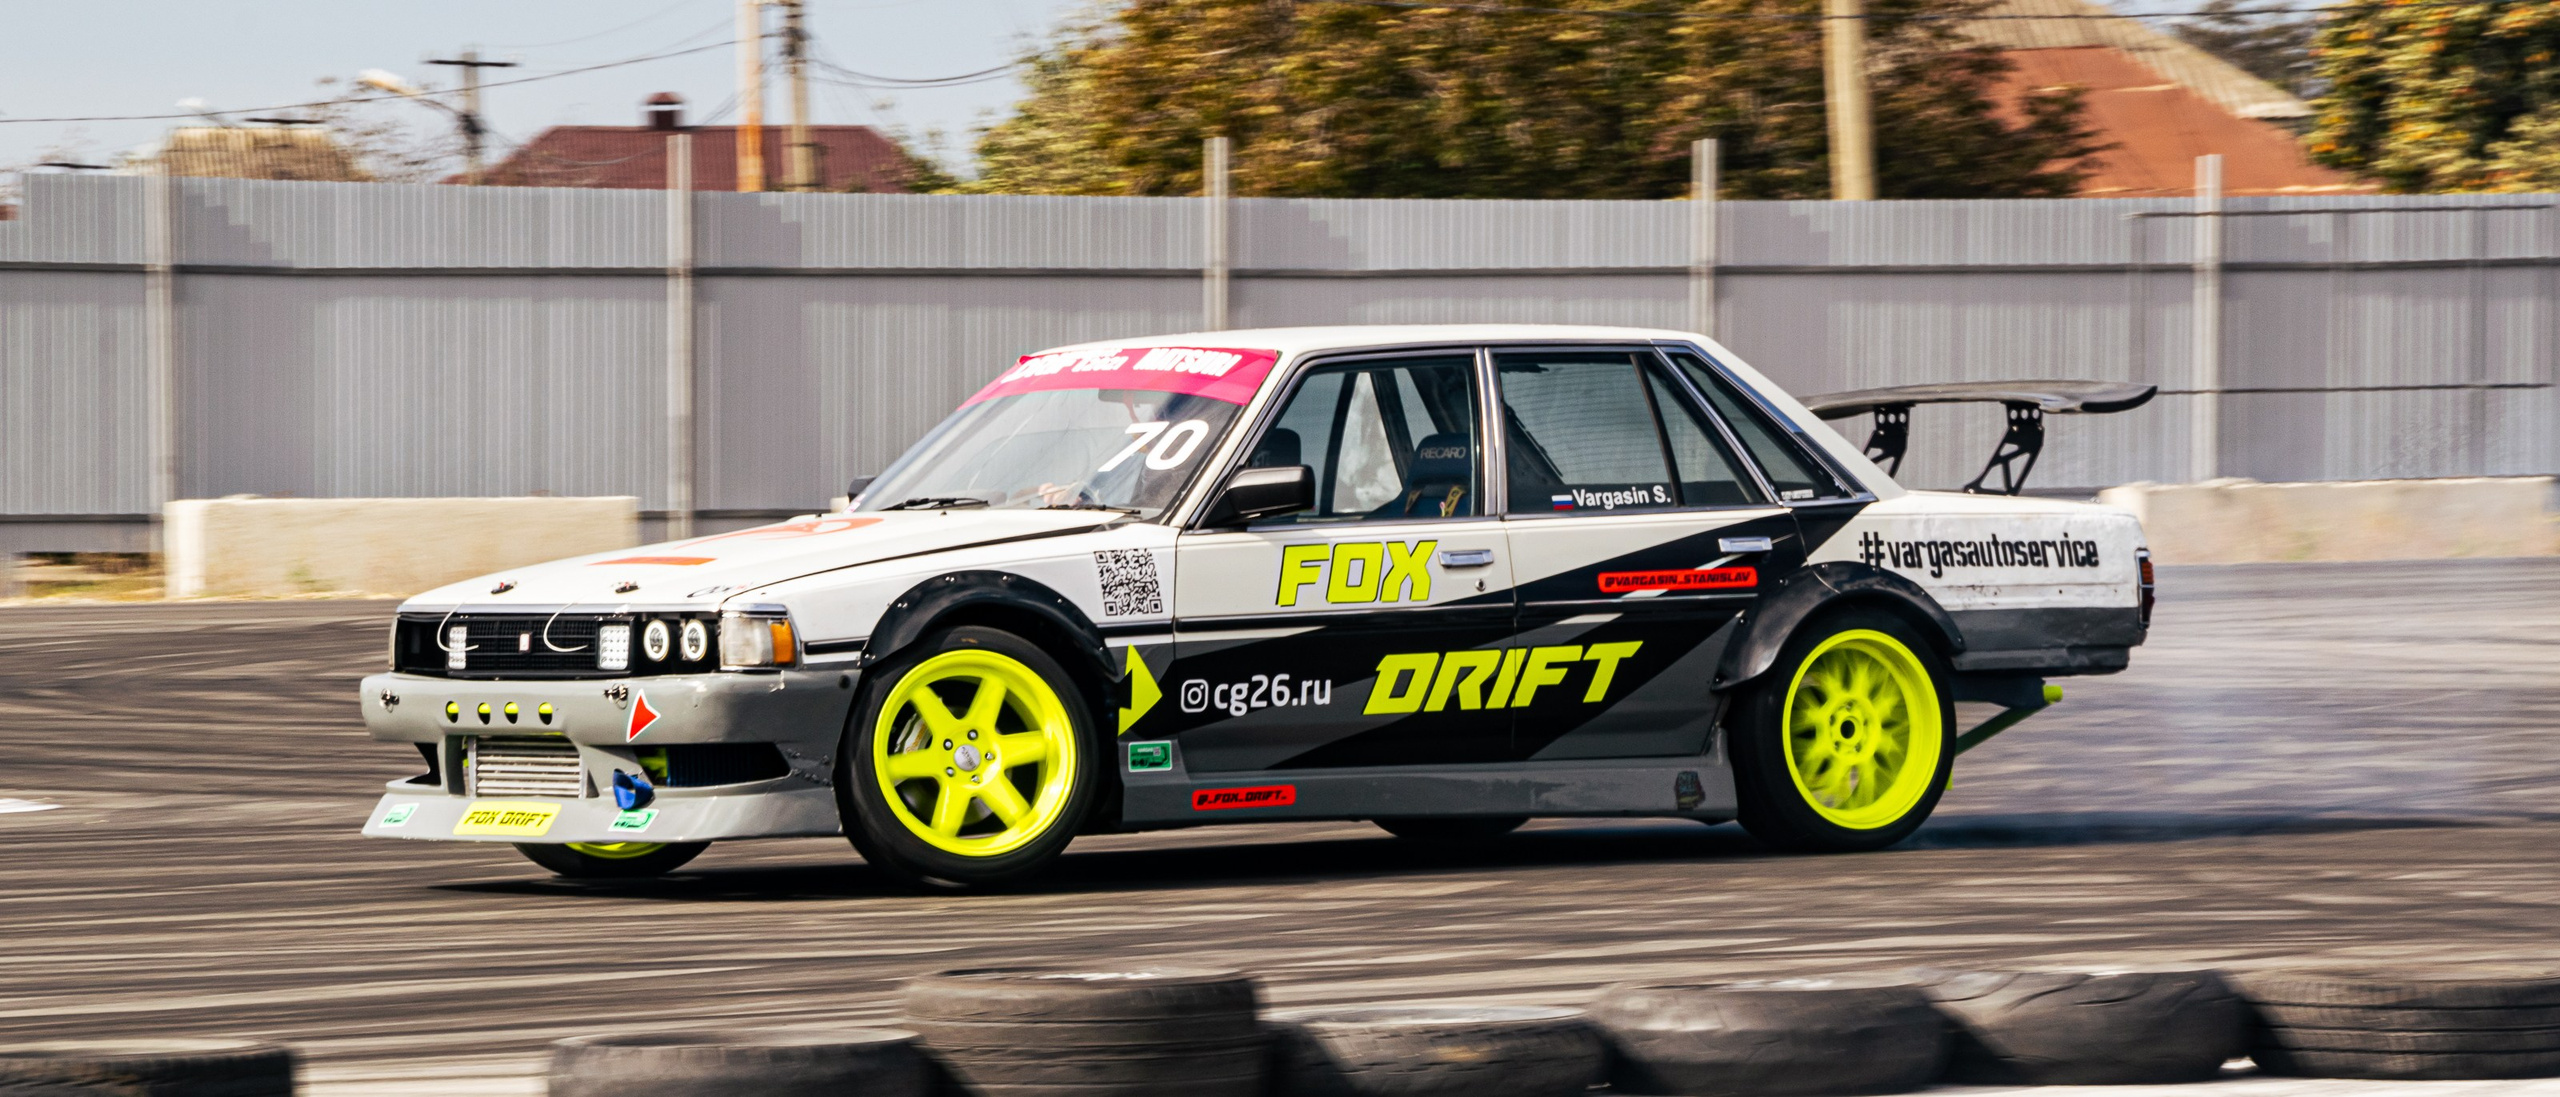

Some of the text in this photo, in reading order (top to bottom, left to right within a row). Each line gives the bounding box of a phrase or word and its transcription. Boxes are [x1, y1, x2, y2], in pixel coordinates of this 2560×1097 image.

[1097, 419, 1209, 472] 70
[1420, 446, 1466, 459] RECARO
[1572, 485, 1671, 510] Vargasin S.
[1275, 540, 1438, 607] FOX
[1858, 531, 2100, 578] #vargasautoservice
[1604, 571, 1751, 588] @VARGASIN_STANISLAV
[1213, 673, 1333, 717] cg26.ru
[1362, 640, 1644, 715] DRIFT
[463, 811, 553, 828] FOX DRIFT
